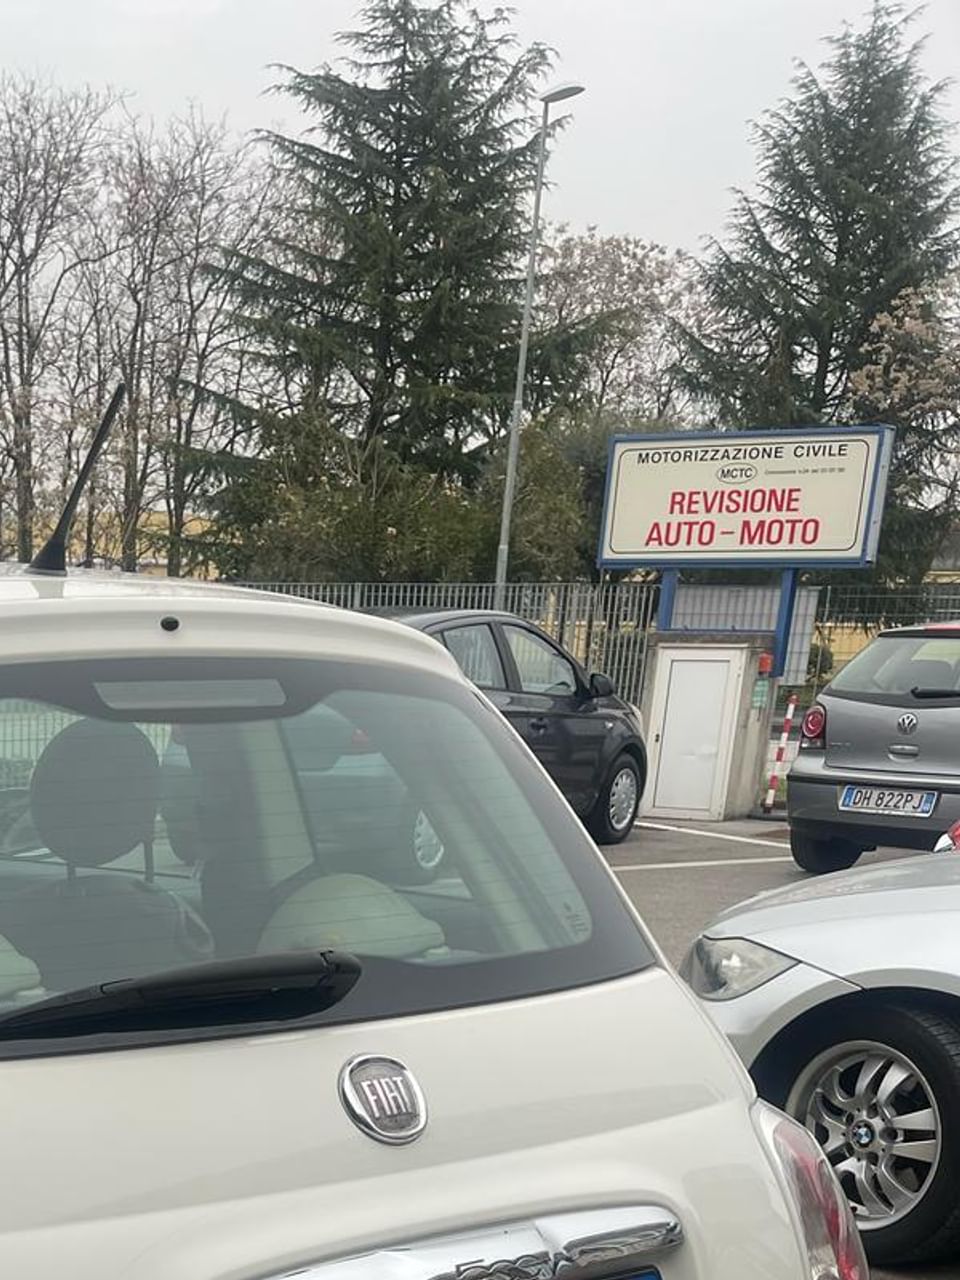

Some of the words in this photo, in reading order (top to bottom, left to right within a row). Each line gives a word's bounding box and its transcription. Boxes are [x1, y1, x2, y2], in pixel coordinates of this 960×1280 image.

[637, 446, 784, 464] MOTORIZZAZIONE
[793, 444, 849, 458] CIVILE
[720, 467, 753, 479] MCTC
[668, 488, 802, 515] REVISIONE
[852, 789, 873, 806] DH
[360, 1076, 412, 1118] FIAT
